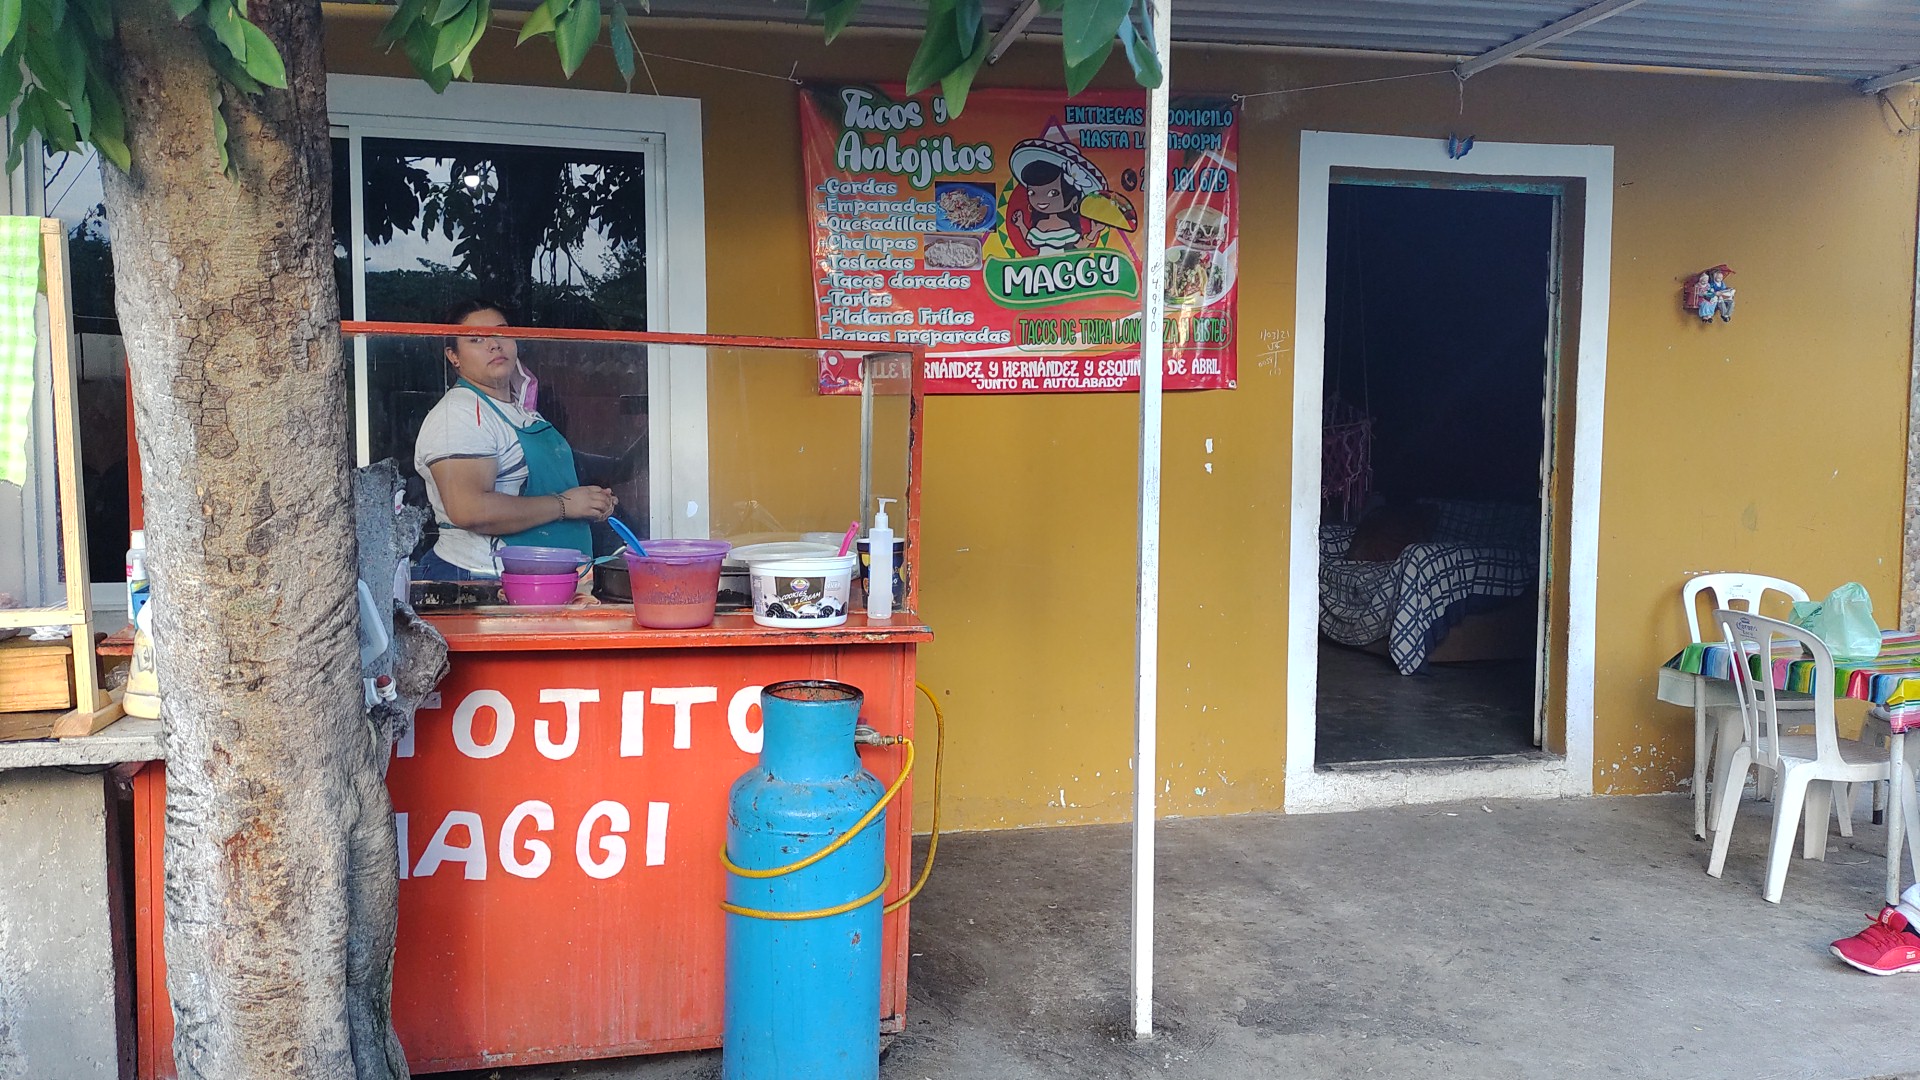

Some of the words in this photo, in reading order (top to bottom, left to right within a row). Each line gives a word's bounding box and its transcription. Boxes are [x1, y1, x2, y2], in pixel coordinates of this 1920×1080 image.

[841, 88, 922, 131] Tacos
[933, 96, 947, 123] y
[1066, 106, 1143, 125] ENTREGAS
[1080, 129, 1130, 149] HASTA
[838, 131, 993, 188] Antojitos
[1172, 167, 1196, 193] 101
[888, 272, 971, 289] dorados
[1003, 256, 1120, 297] MAGGY
[918, 308, 975, 326] Fritos
[895, 327, 1012, 346] preparadas
[1019, 318, 1058, 345] TACOS
[1061, 318, 1077, 345] DE
[1079, 318, 1113, 345] TRIPA
[1193, 318, 1227, 343] BISTEC
[988, 362, 999, 379] Y
[1002, 357, 1079, 378] HERNÁNDEZ
[1084, 361, 1094, 377] Y
[1168, 358, 1187, 375] DE
[1191, 357, 1221, 375] ABRIL
[1021, 377, 1039, 389] AL
